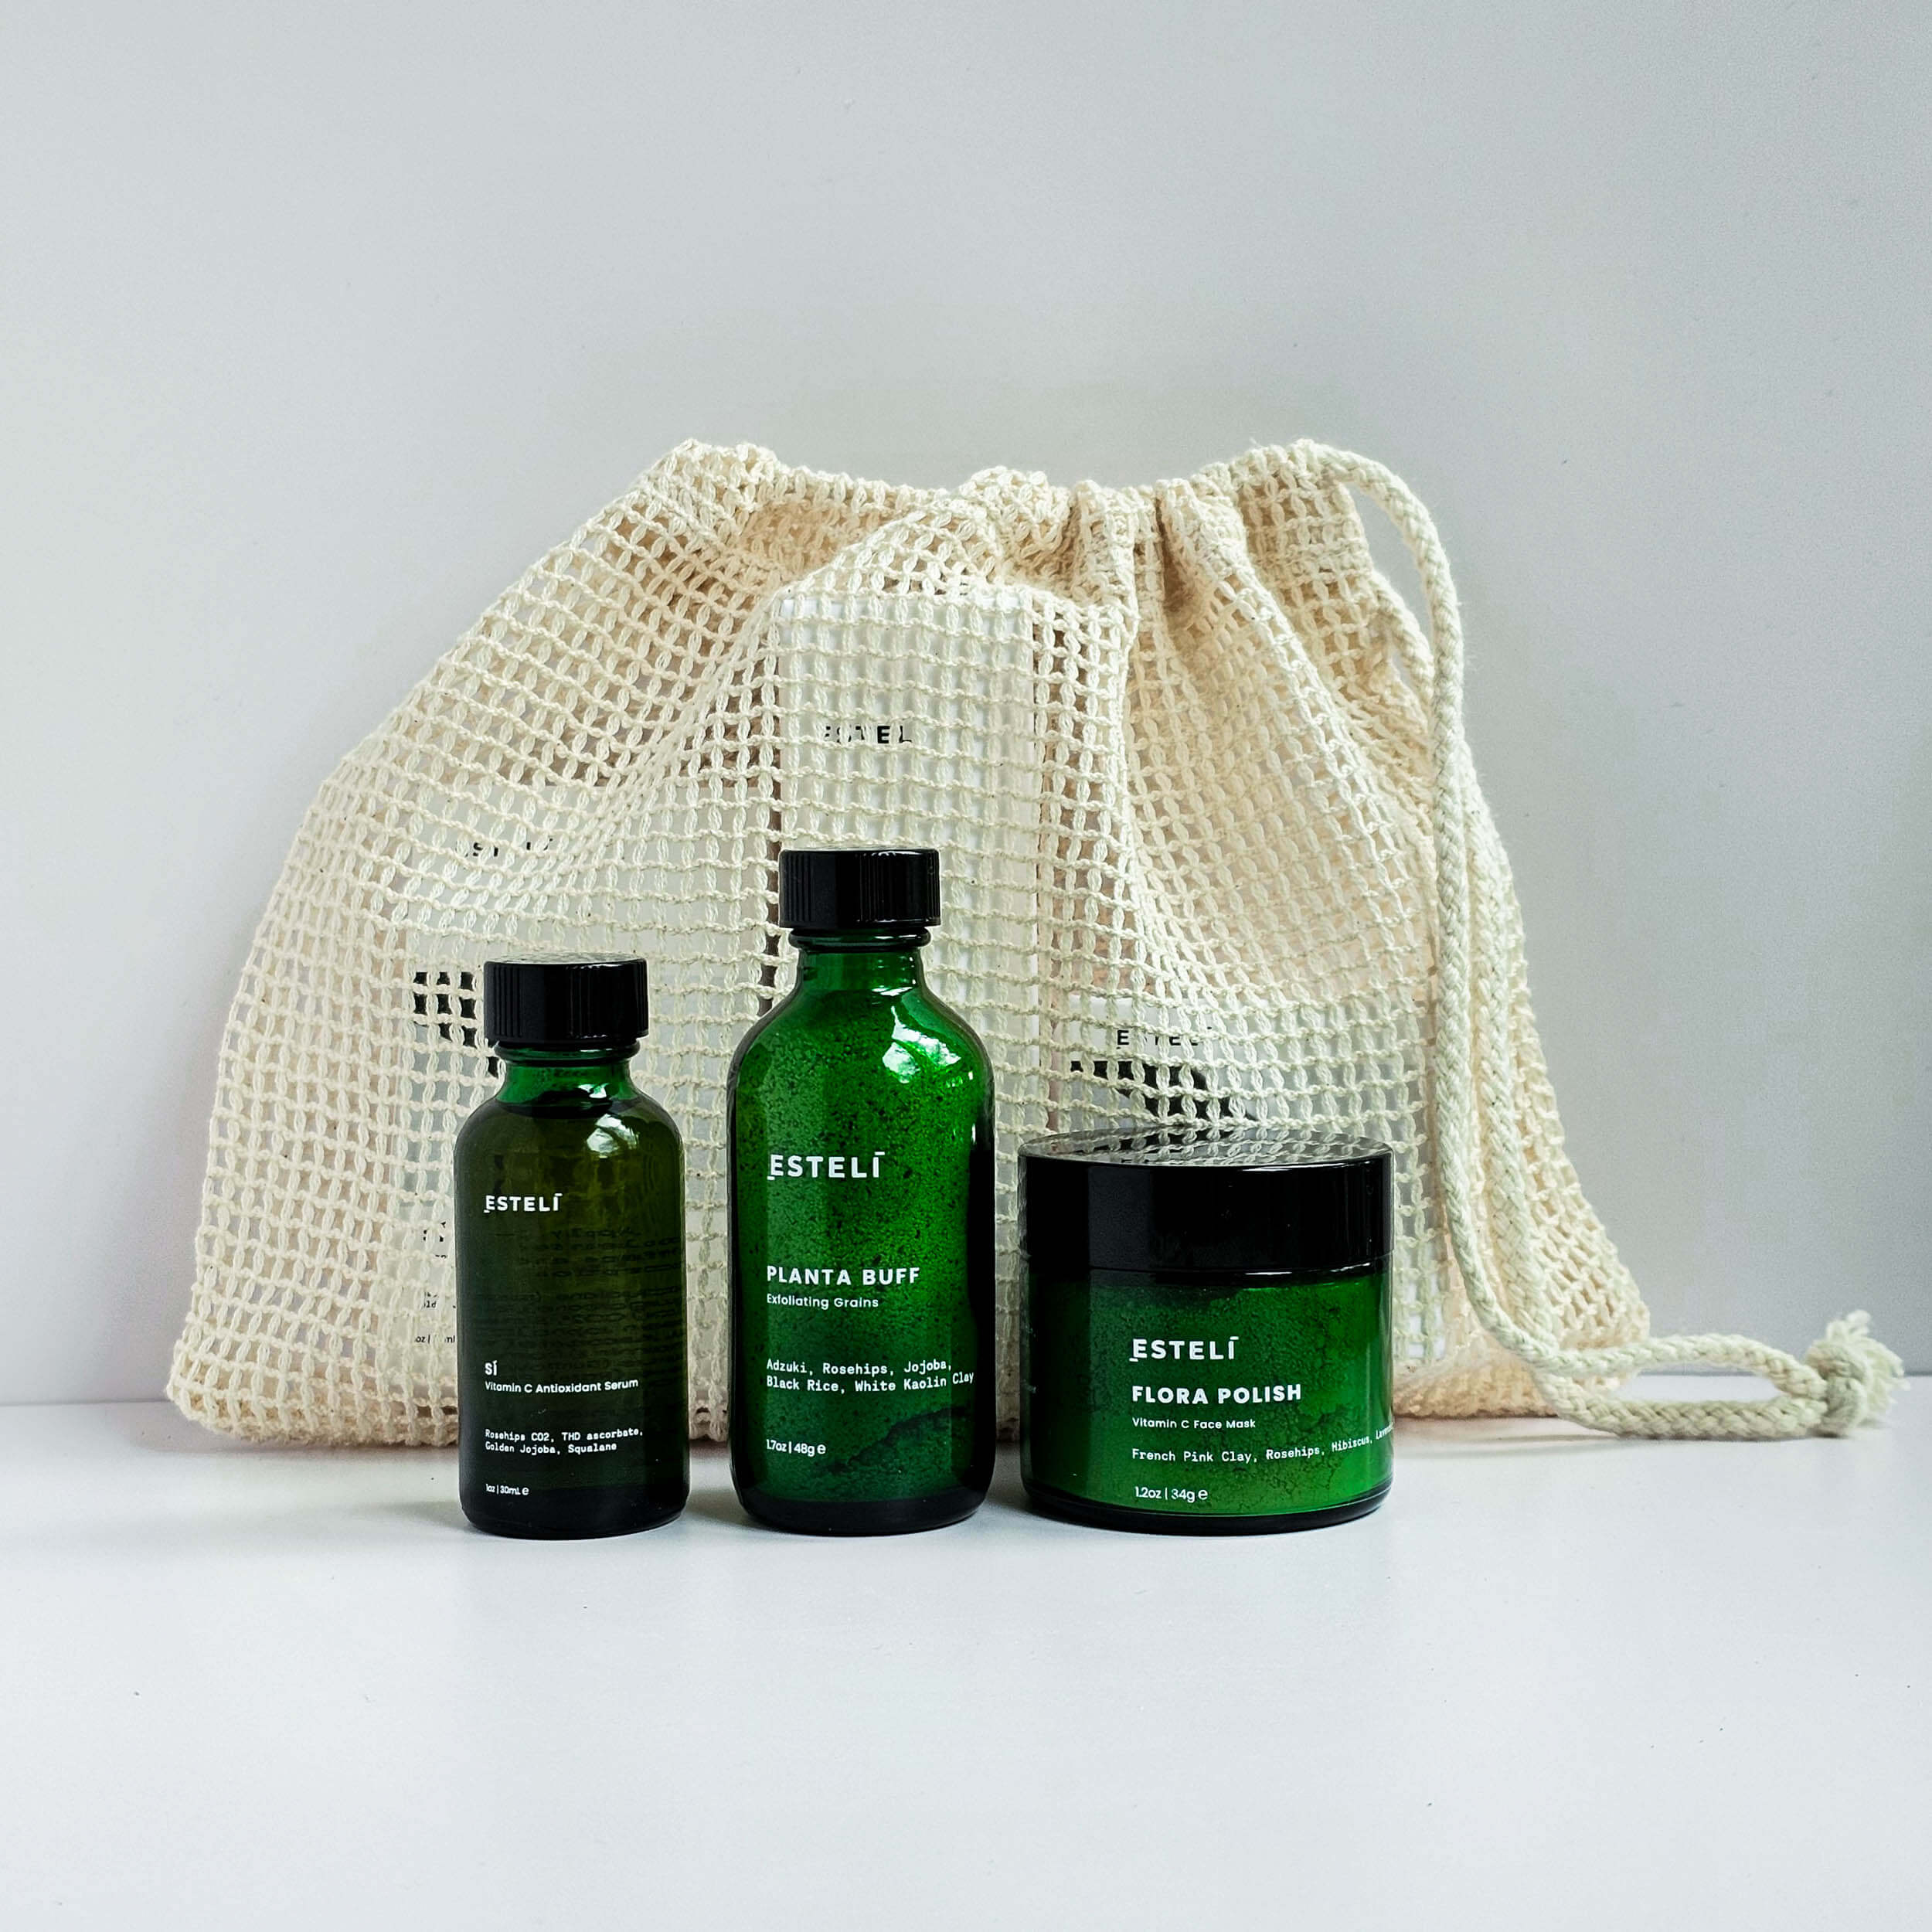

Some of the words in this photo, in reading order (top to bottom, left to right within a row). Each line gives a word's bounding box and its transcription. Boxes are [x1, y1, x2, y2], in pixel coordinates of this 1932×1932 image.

[767, 1265, 852, 1286] PLANTA
[862, 1267, 920, 1286] BUFF
[767, 1293, 829, 1311] Exfoliating
[833, 1298, 879, 1308] Grains
[766, 1359, 814, 1376] Adzuki,
[822, 1362, 894, 1378] Rosehips,
[903, 1359, 952, 1375] Jojoba,
[485, 1381, 522, 1393] Vitamin
[524, 1383, 533, 1393] C
[535, 1382, 602, 1394] Antioxidant
[604, 1379, 639, 1391] Serum
[766, 1375, 800, 1390] Black
[807, 1379, 845, 1395] Rice,
[855, 1379, 896, 1392] White
[903, 1376, 947, 1390] Kaolin
[952, 1371, 975, 1385] Clay
[1131, 1385, 1209, 1405] FLORA
[1217, 1383, 1302, 1404] POLISH
[1132, 1417, 1177, 1429] Vitamin
[1181, 1420, 1190, 1429] C
[1193, 1420, 1223, 1430] Face
[1226, 1418, 1256, 1430] Mask
[485, 1428, 526, 1443] Rosehips
[561, 1431, 581, 1441] THD
[586, 1427, 643, 1440] ascorbate,
[485, 1440, 515, 1453] Golden
[519, 1443, 561, 1456] Jojoba,
[567, 1442, 618, 1456] Squalane
[1132, 1448, 1176, 1462] French
[1183, 1451, 1214, 1462] Pink
[1221, 1451, 1258, 1464] Clay,
[1265, 1446, 1325, 1461] Rosehips,
[1332, 1436, 1372, 1453] Hibiscus,
